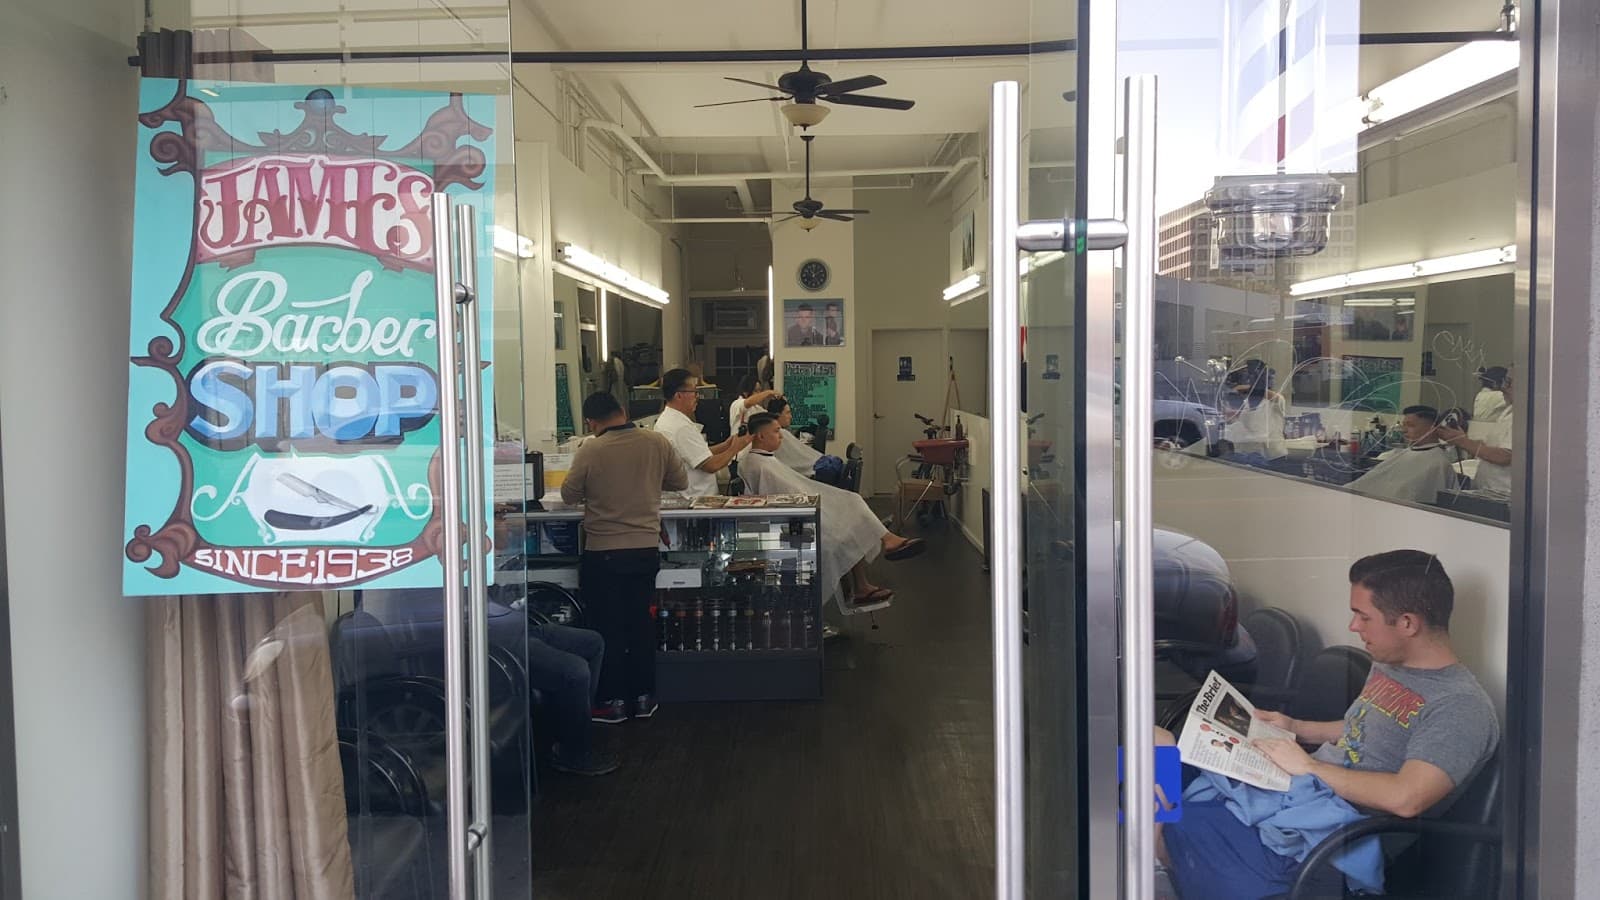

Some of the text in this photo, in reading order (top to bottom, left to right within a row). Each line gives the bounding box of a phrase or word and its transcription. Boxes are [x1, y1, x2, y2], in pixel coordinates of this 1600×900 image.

[200, 163, 434, 258] JAMES
[197, 271, 436, 357] Barber
[190, 361, 437, 440] SHOP
[1196, 699, 1211, 715] The
[1203, 676, 1222, 703] Brief
